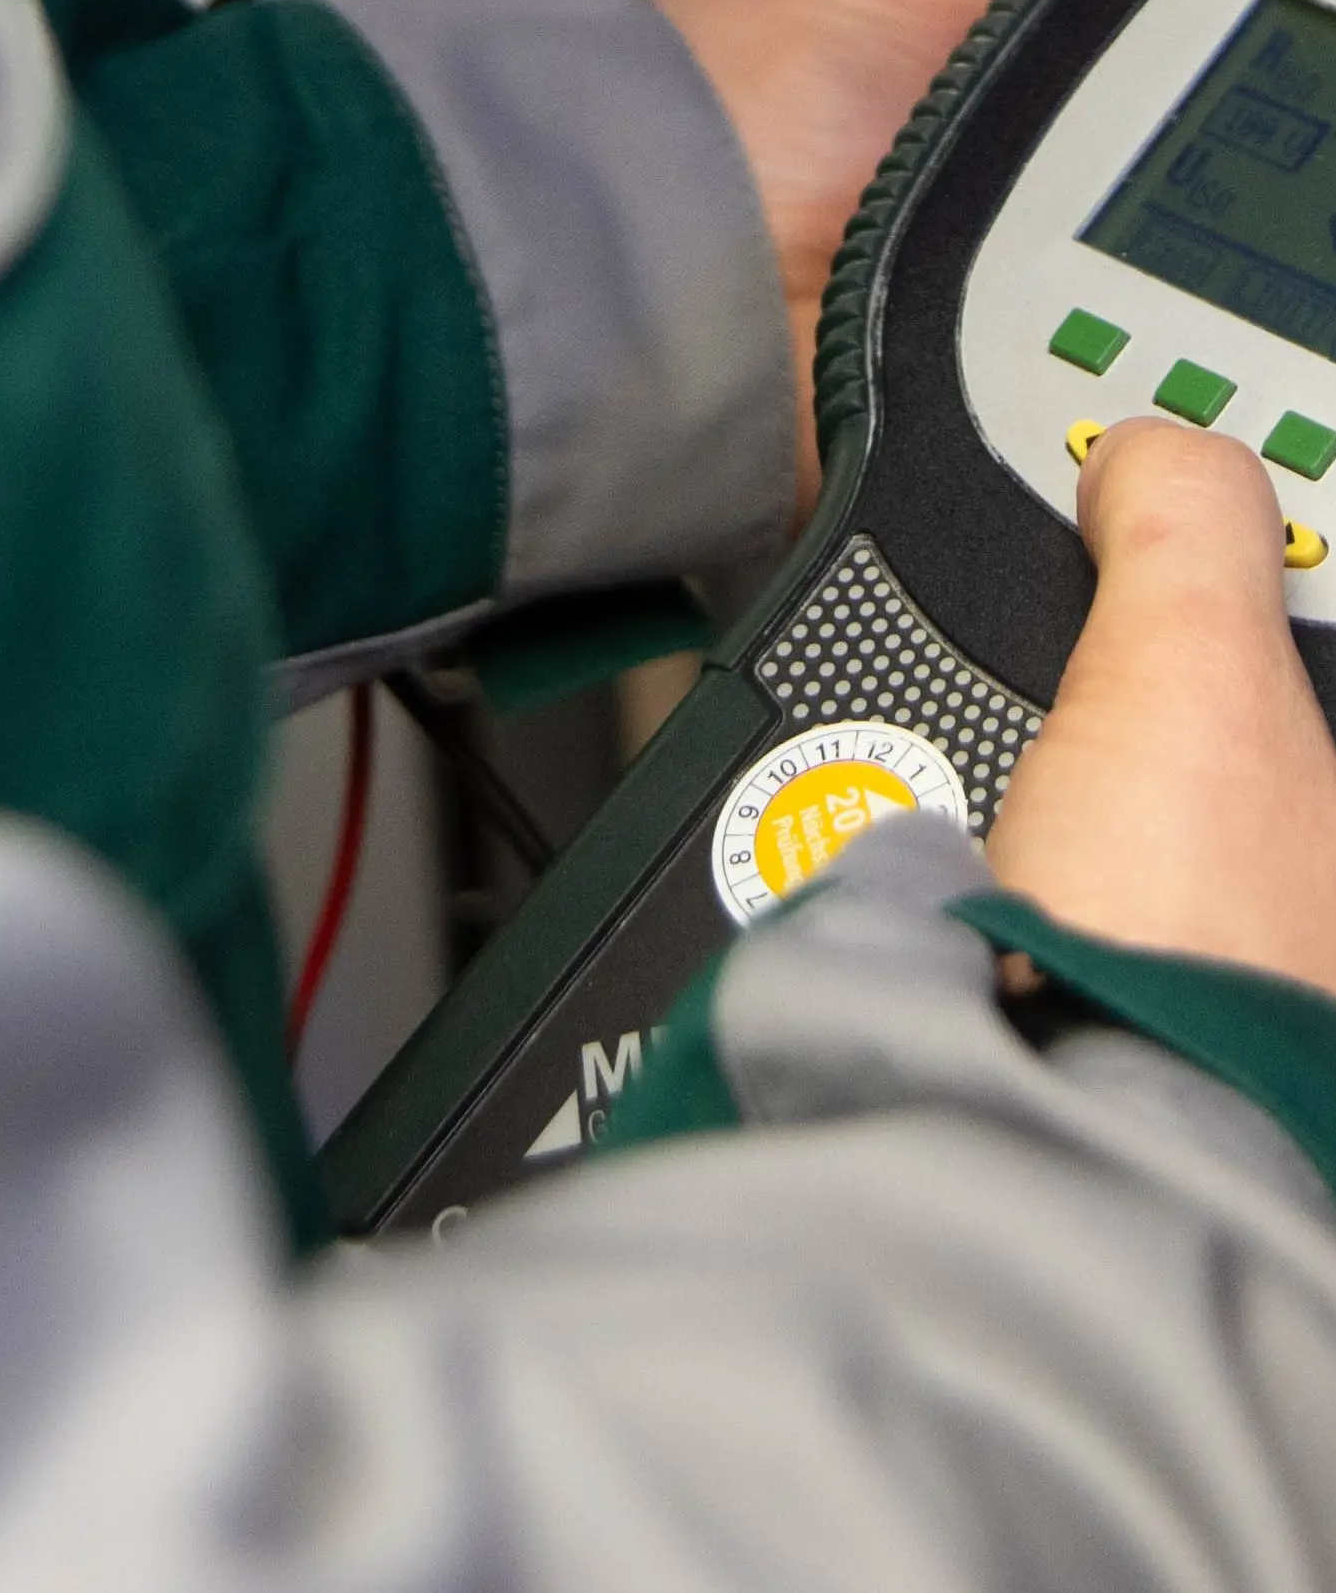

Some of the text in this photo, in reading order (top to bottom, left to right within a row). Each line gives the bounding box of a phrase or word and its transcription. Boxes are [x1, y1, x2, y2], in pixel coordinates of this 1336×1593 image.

[815, 739, 842, 761] 11
[866, 739, 894, 763] 12
[767, 759, 797, 785] 10
[909, 762, 928, 782] 1
[738, 804, 760, 821] 9
[825, 785, 866, 833] 20
[729, 850, 752, 866] 8
